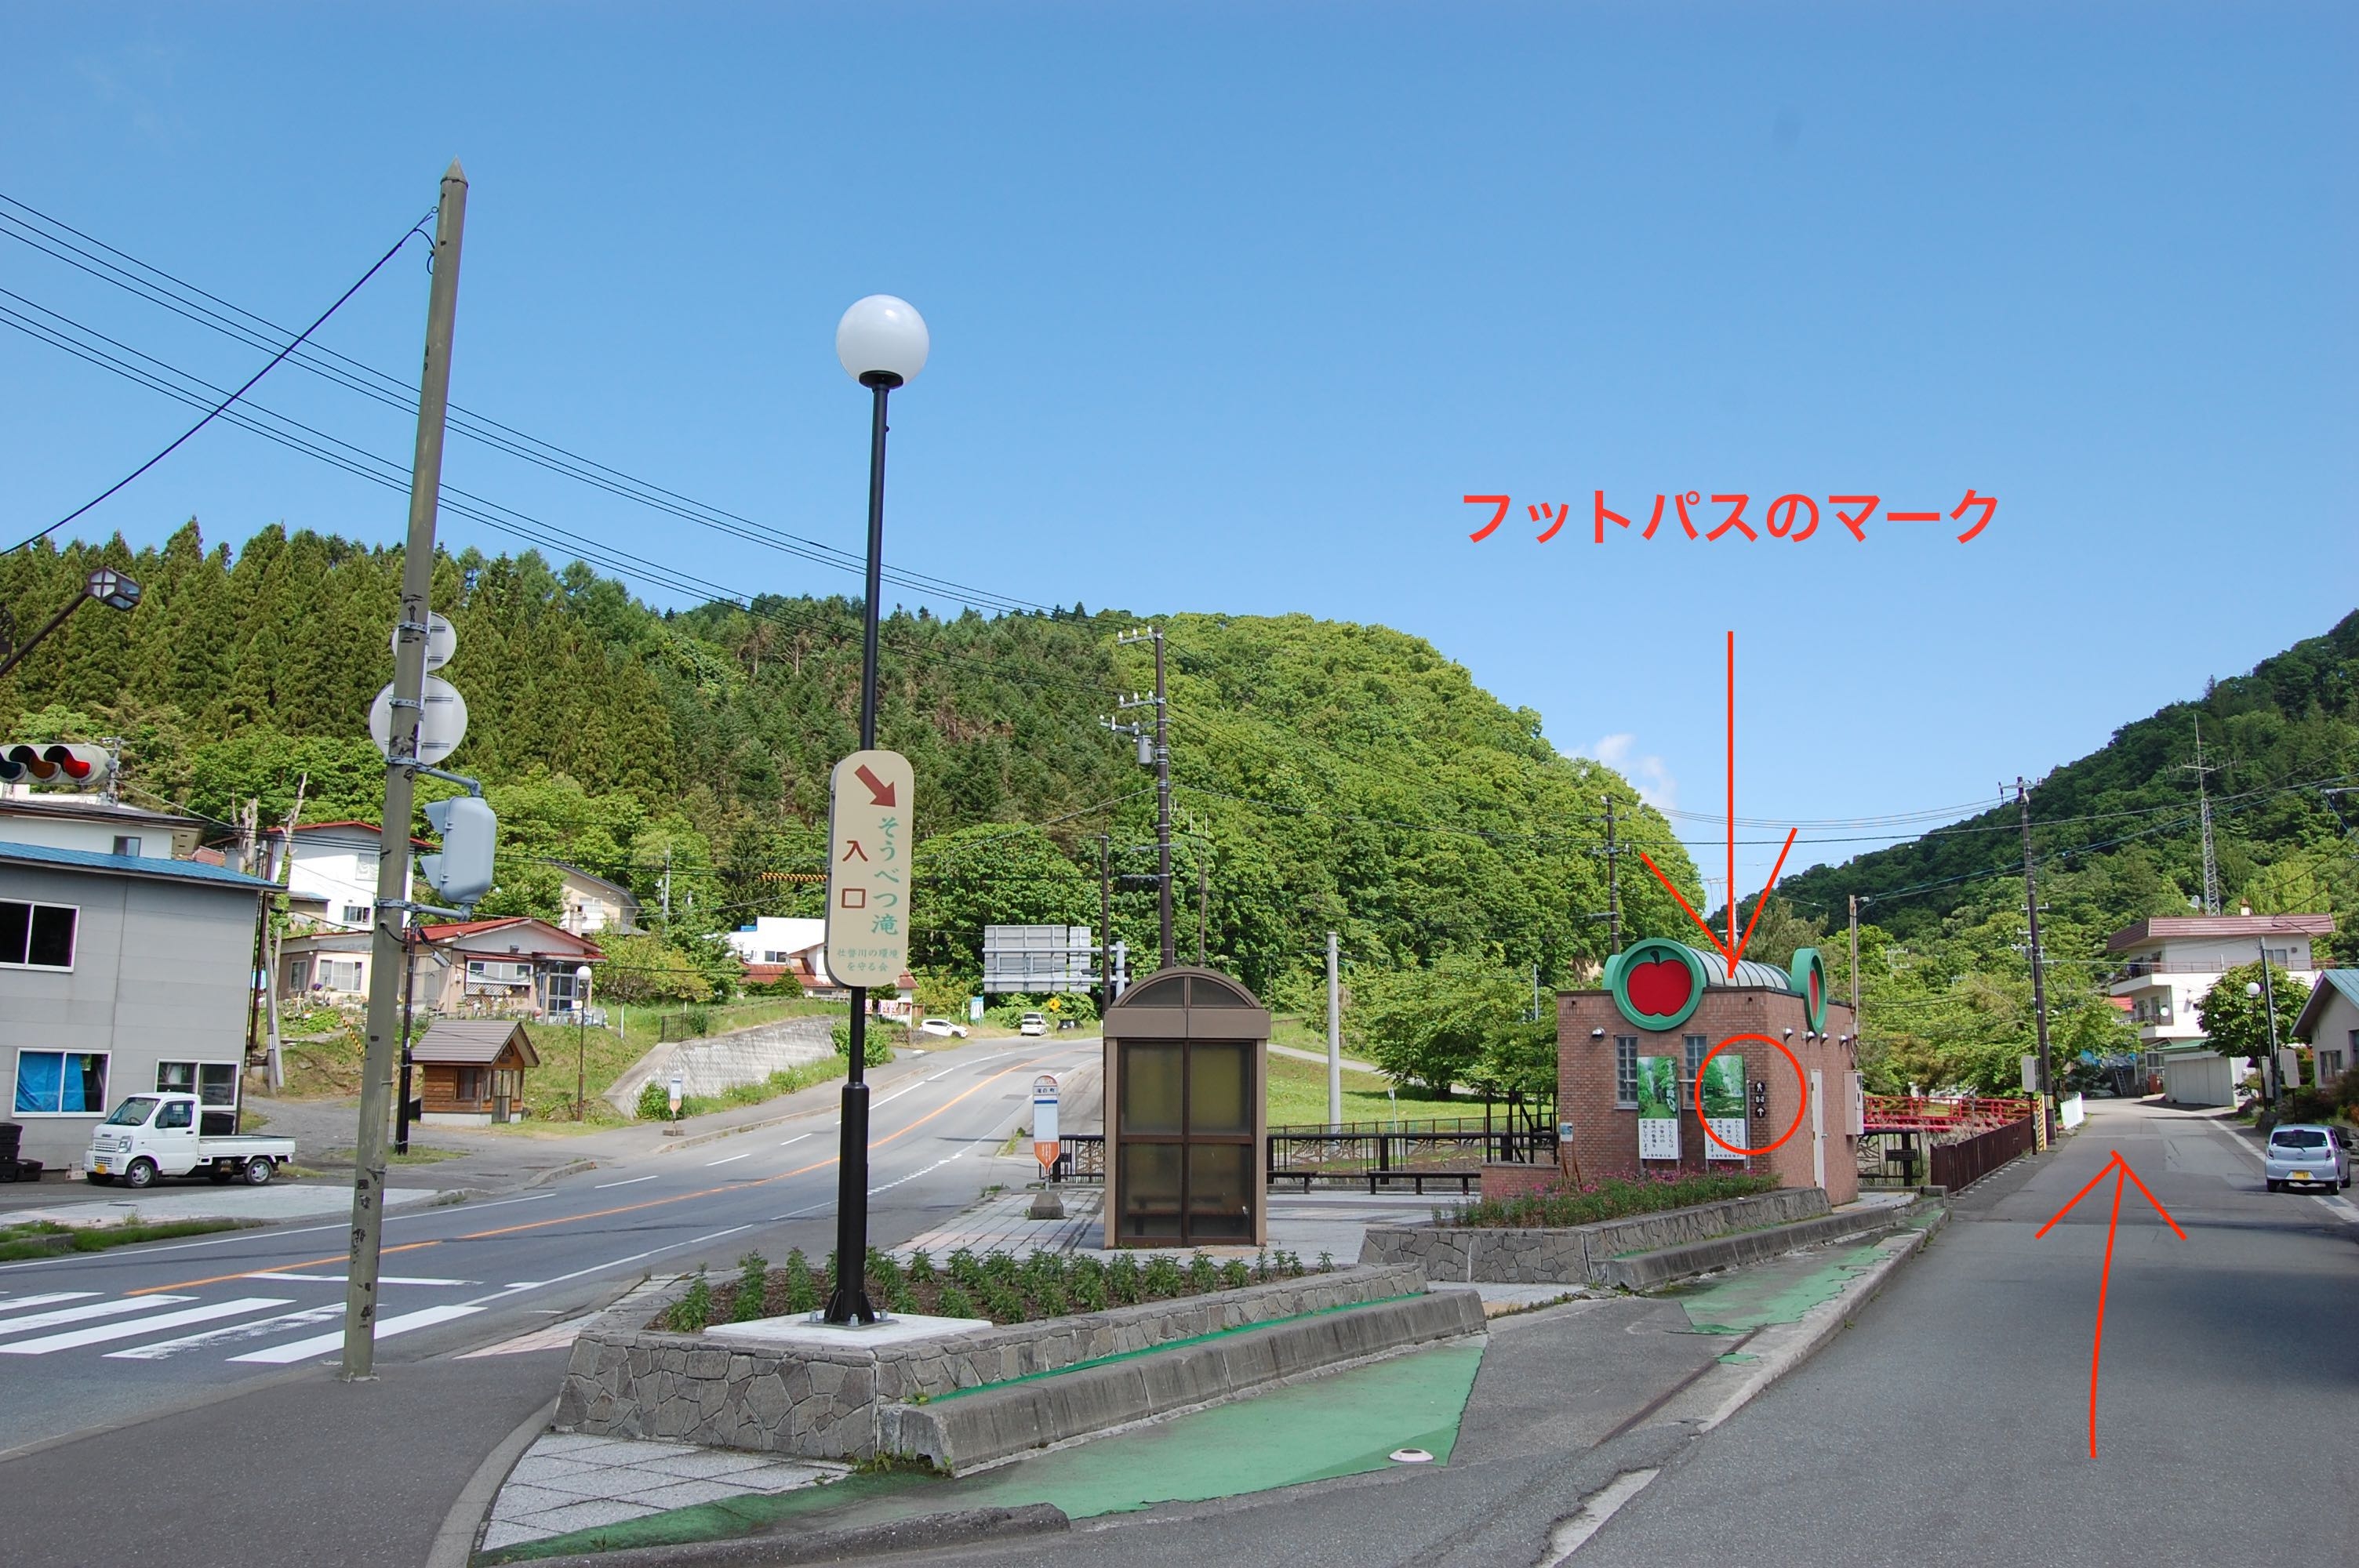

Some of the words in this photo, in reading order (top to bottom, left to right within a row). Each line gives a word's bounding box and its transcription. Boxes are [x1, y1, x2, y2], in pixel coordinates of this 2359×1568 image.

[841, 840, 868, 909] 入口
[871, 816, 900, 935] そうべつ滝
[847, 961, 889, 971] を守る会
